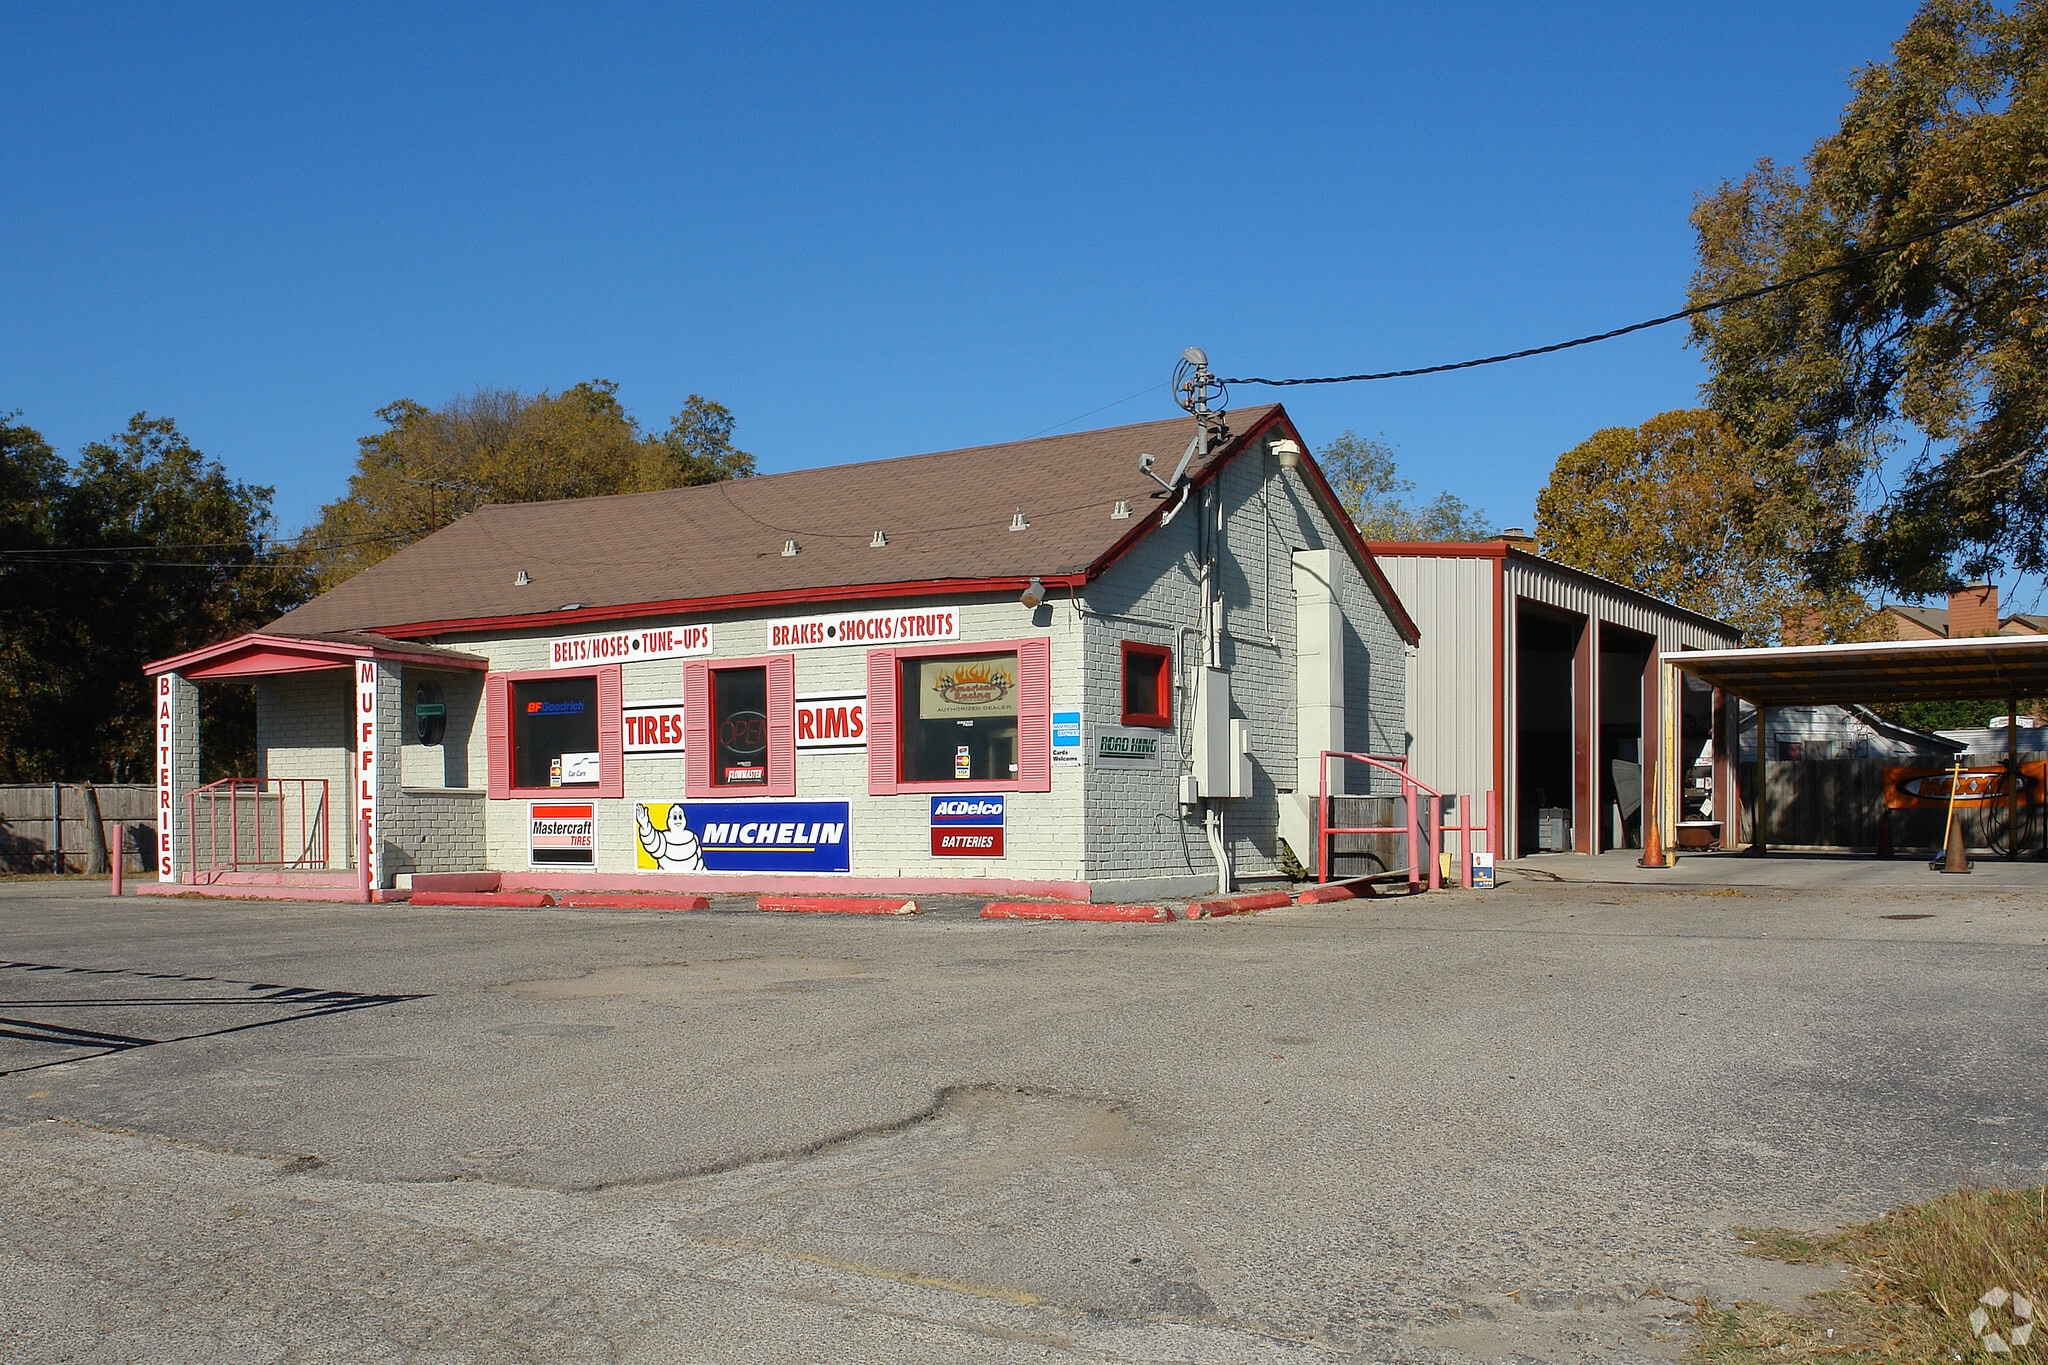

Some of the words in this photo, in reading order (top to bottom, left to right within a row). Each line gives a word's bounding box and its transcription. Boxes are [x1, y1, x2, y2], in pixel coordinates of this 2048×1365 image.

[773, 623, 824, 646] BRAKES
[839, 613, 953, 641] SHOCKS/STRUTS
[554, 635, 629, 663] BELTS/HOSES
[641, 626, 708, 653] TUNE-UPS
[950, 684, 997, 693] American
[527, 701, 585, 713] BFGoodrich
[625, 714, 683, 745] TIRES
[798, 706, 864, 739] RIMS
[1100, 736, 1129, 752] ROAD
[1131, 738, 1157, 753] KING
[160, 677, 171, 876] BATTERIES
[1918, 776, 2014, 796] MAXXI
[934, 801, 1003, 815] ACDelco
[533, 821, 592, 835] Mastercraft
[702, 823, 844, 844] MICHELIN
[570, 836, 592, 846] TIRES
[941, 836, 994, 848] BATTERIES
